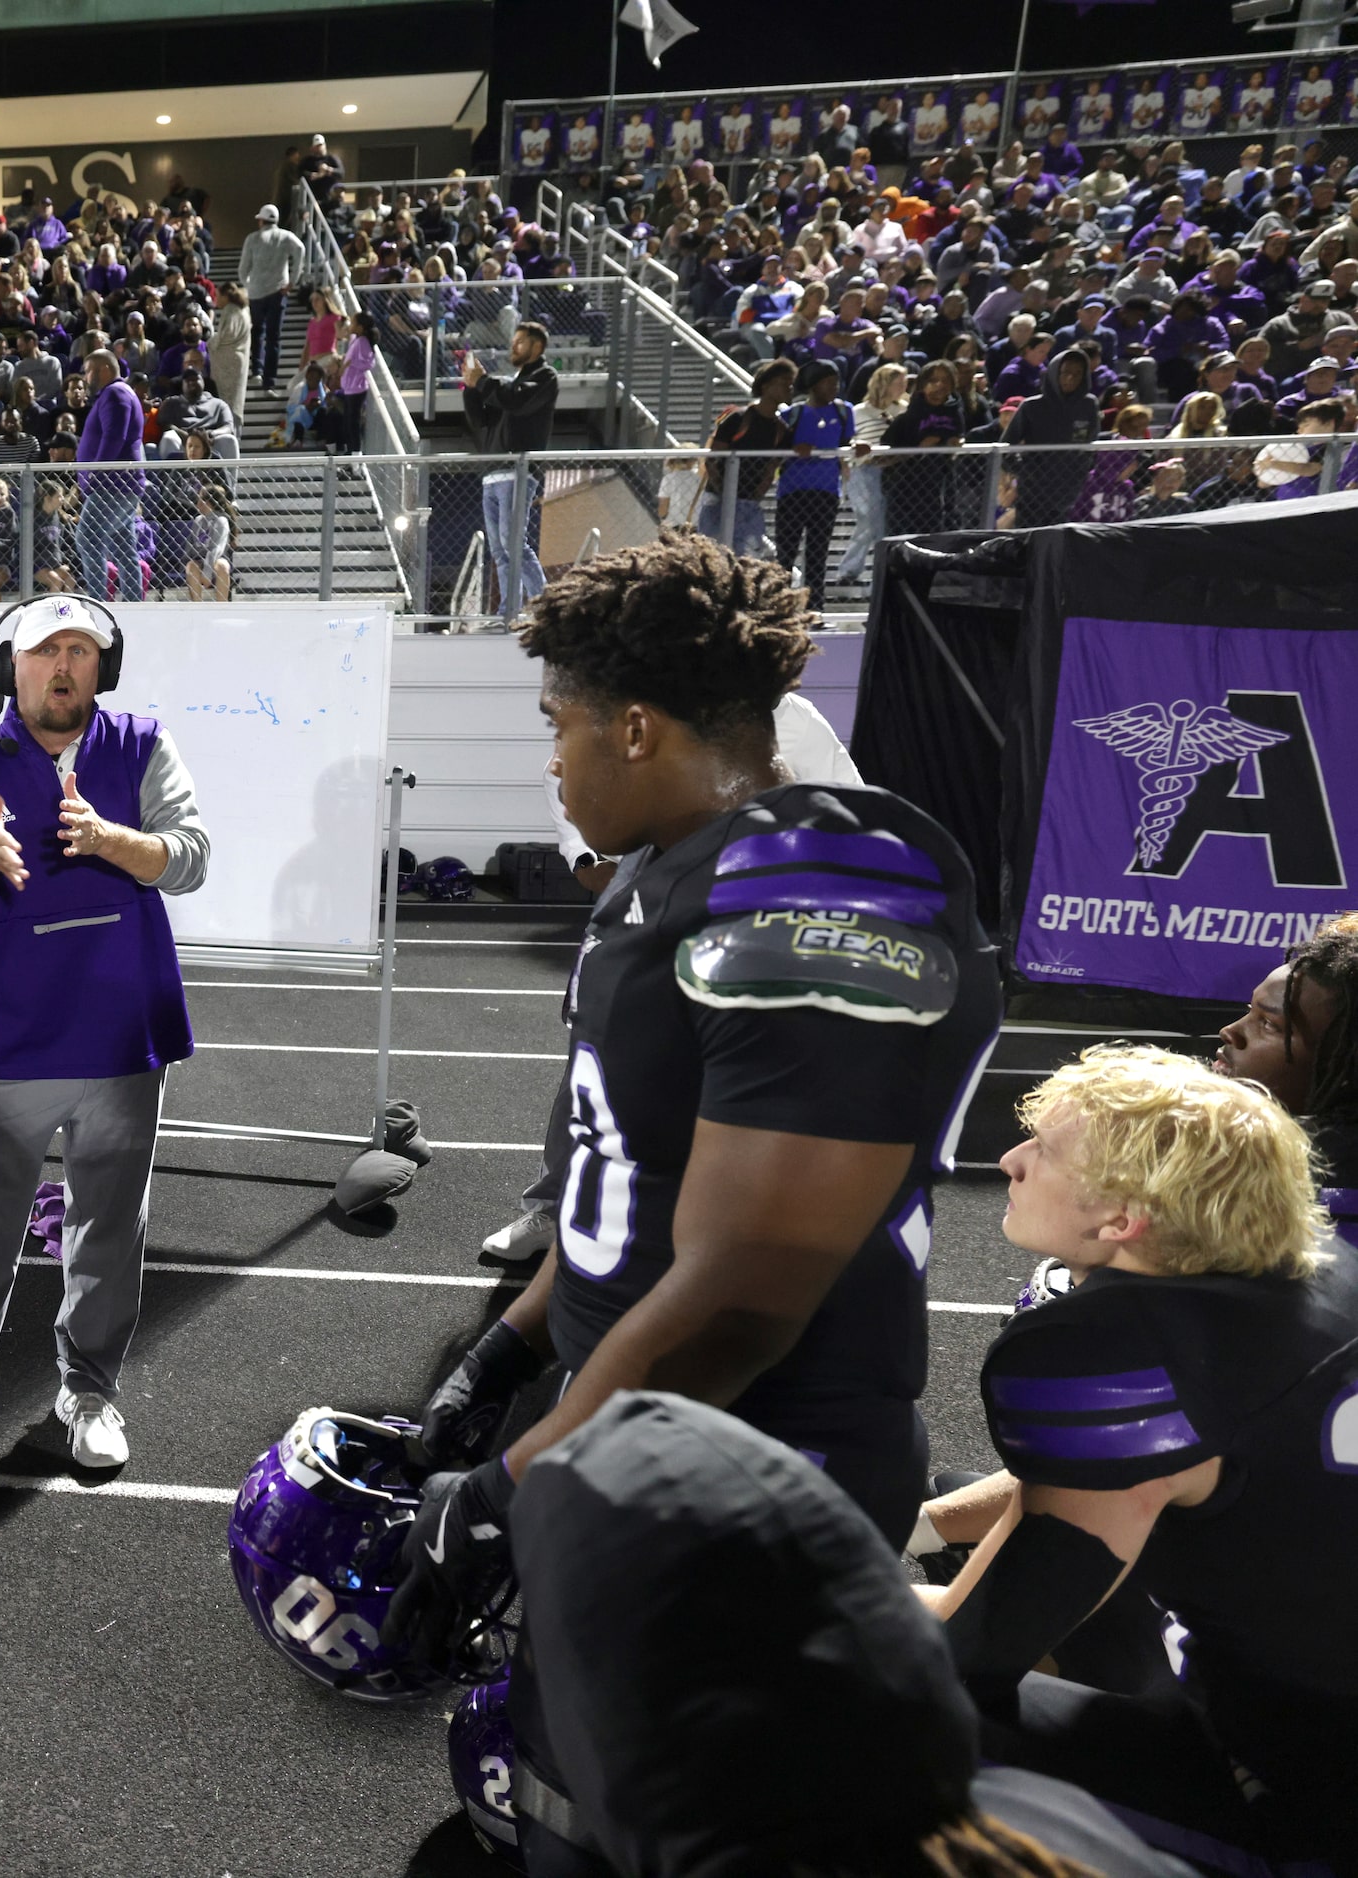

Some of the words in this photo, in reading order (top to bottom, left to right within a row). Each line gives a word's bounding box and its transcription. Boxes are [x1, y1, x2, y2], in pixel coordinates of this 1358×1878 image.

[1124, 689, 1348, 889] A
[1038, 894, 1161, 938] SPORTS
[1164, 903, 1340, 949] MEDICIN
[793, 923, 925, 981] GEAR
[1026, 961, 1086, 977] KINEMATIC
